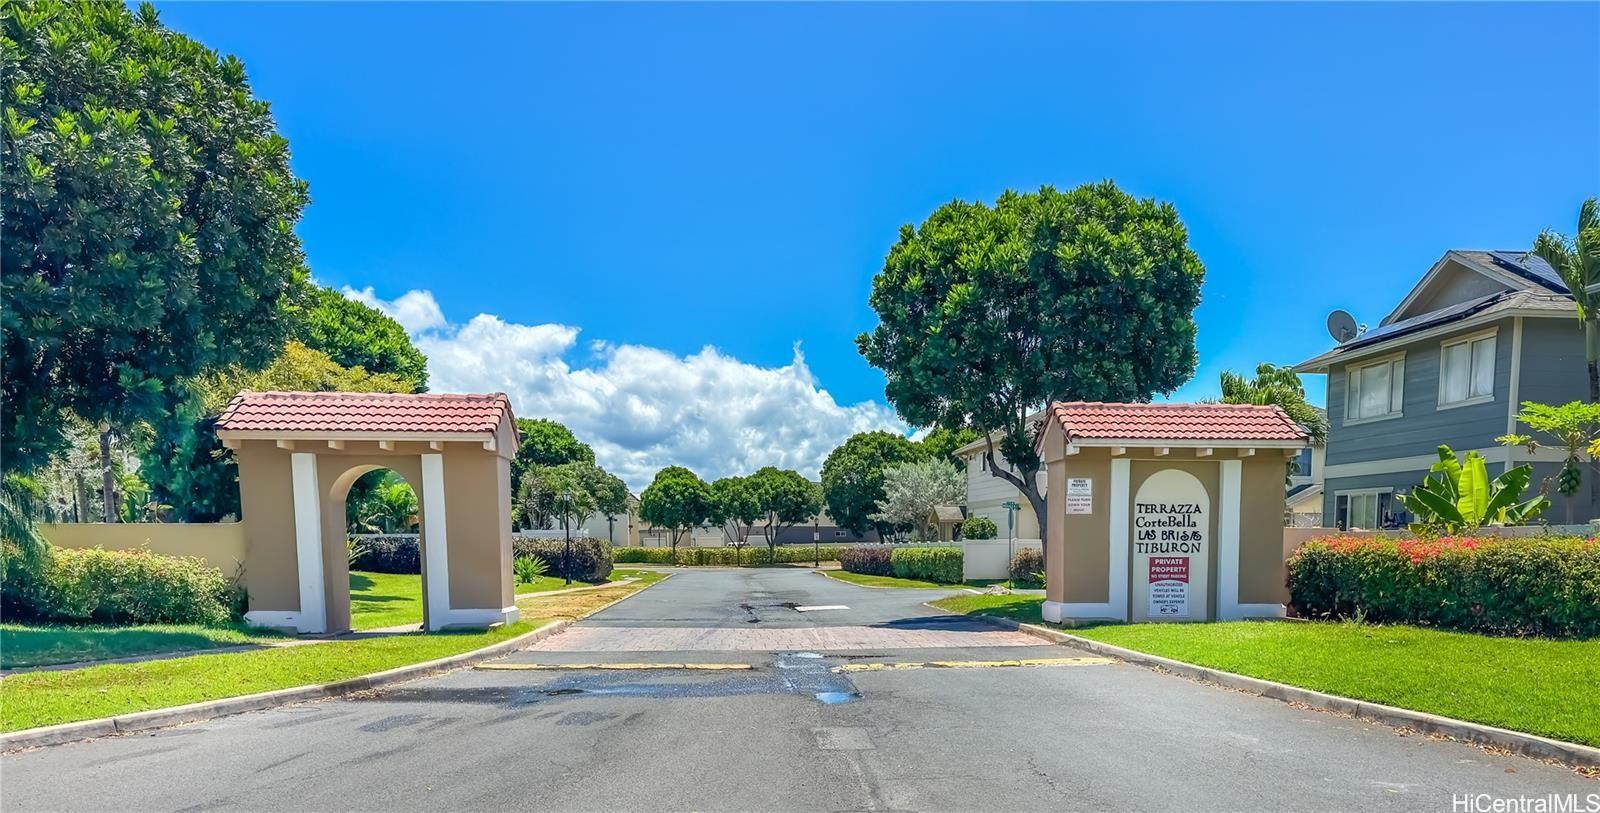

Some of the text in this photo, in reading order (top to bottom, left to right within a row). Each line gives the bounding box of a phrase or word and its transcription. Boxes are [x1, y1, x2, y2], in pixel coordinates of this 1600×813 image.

[1136, 503, 1202, 514] TERRAZZA
[1135, 514, 1197, 528] CorteBella
[1138, 529, 1202, 541] LAS BRISAS
[1136, 542, 1201, 554] TIBURON
